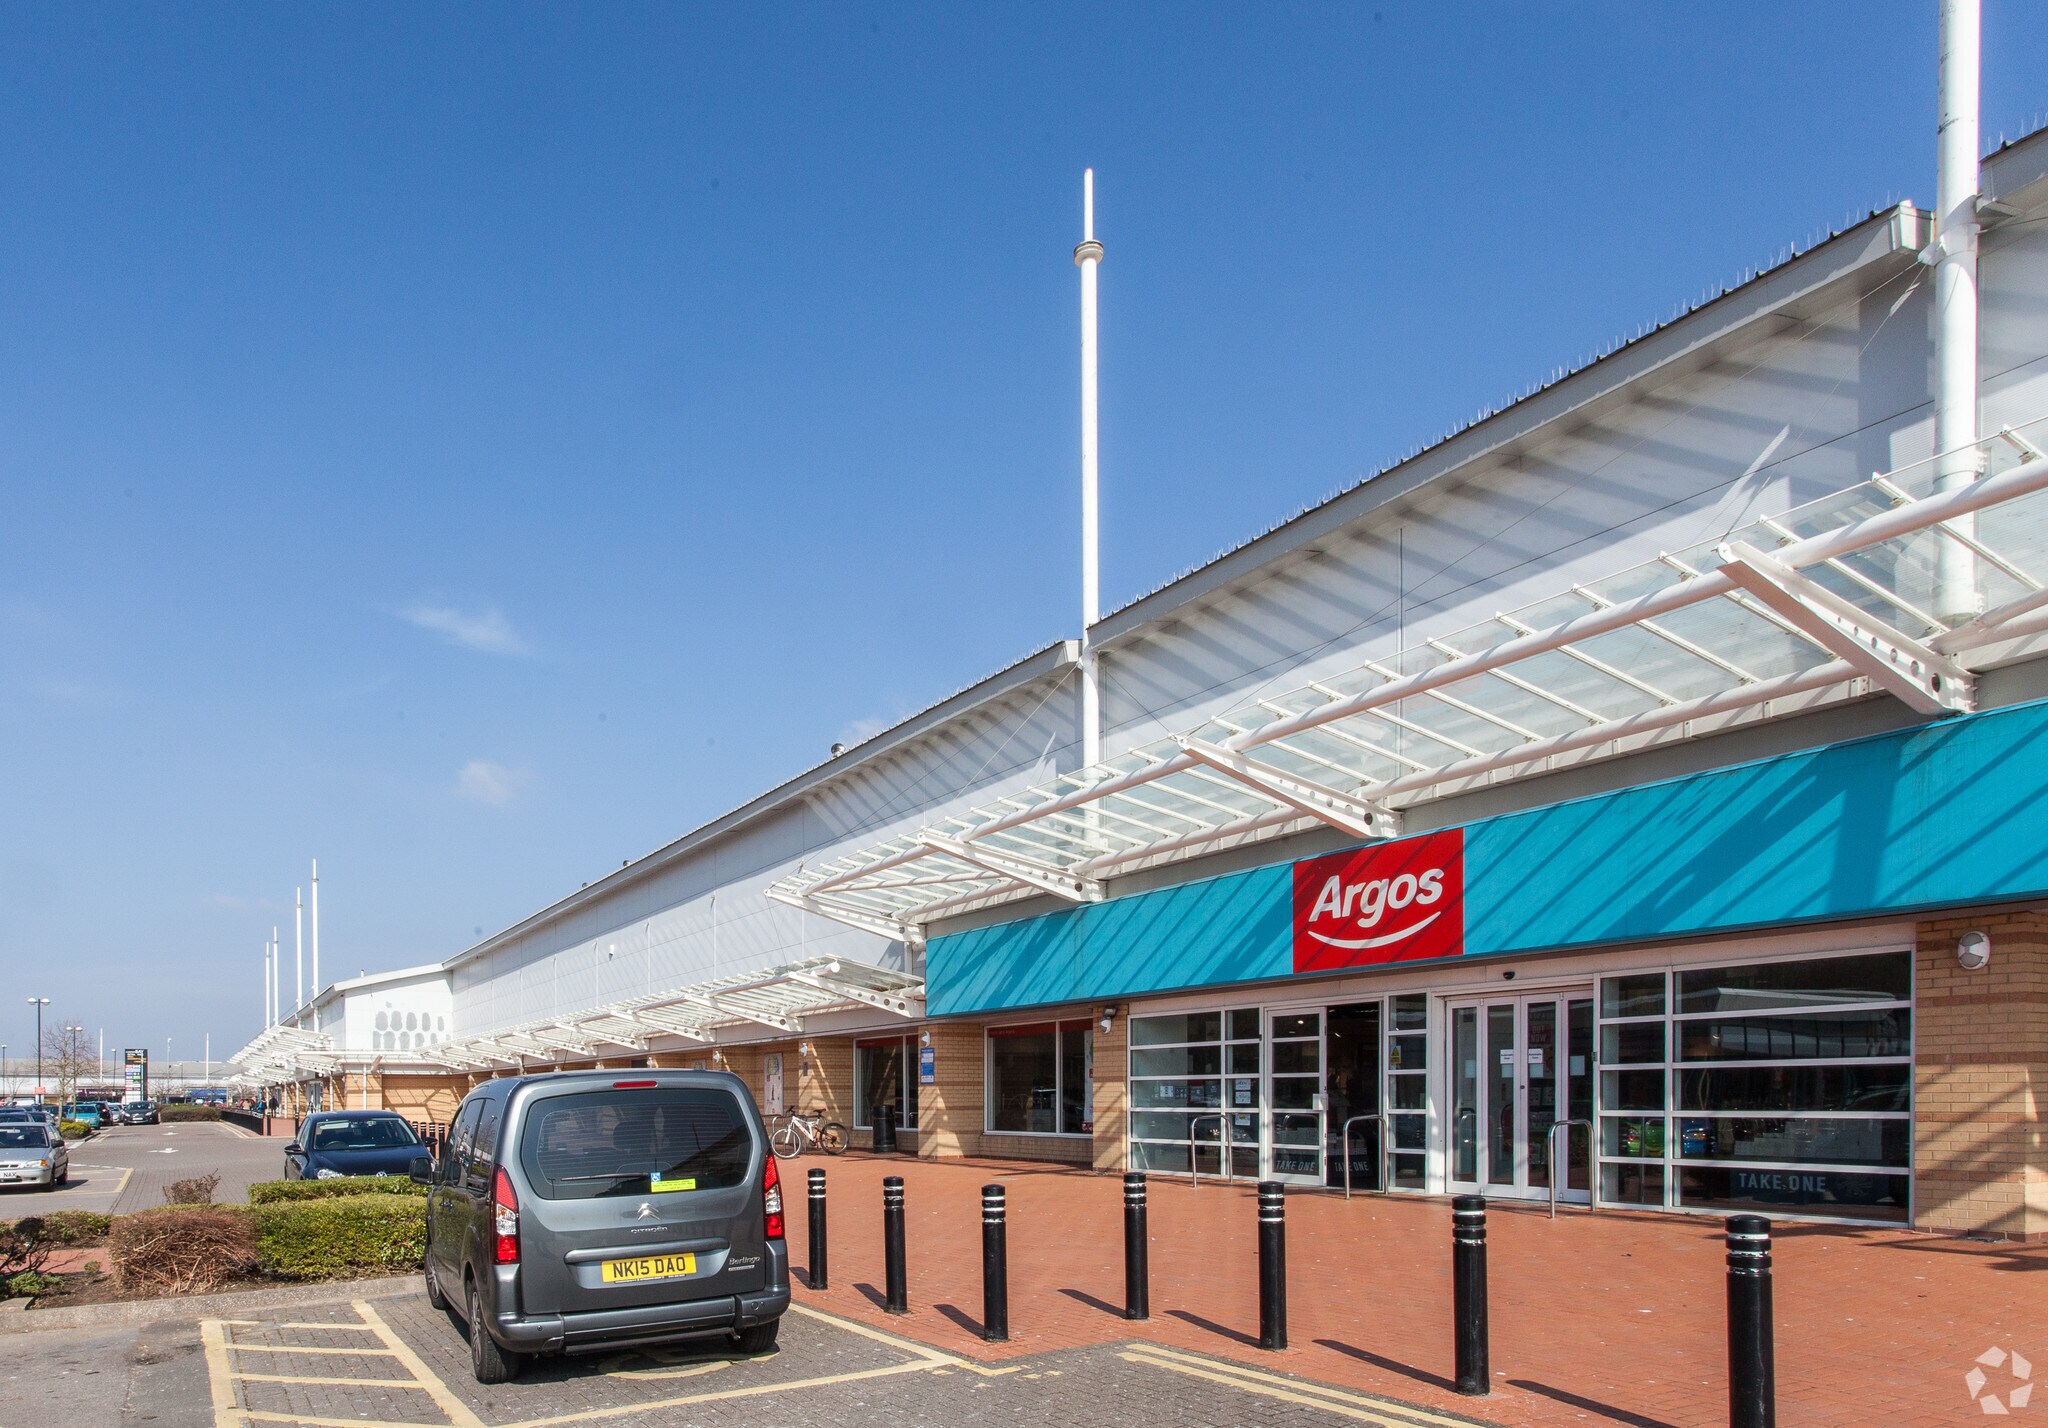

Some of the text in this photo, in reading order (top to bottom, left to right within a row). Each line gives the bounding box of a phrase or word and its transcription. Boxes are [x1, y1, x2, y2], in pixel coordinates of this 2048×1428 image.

[1308, 868, 1445, 928] Argos
[1276, 1160, 1316, 1172] TAKE ONE
[1334, 1161, 1369, 1172] TAE ONE
[1738, 1172, 1827, 1192] TAKE ONE
[613, 1257, 686, 1278] NK15 DAO
